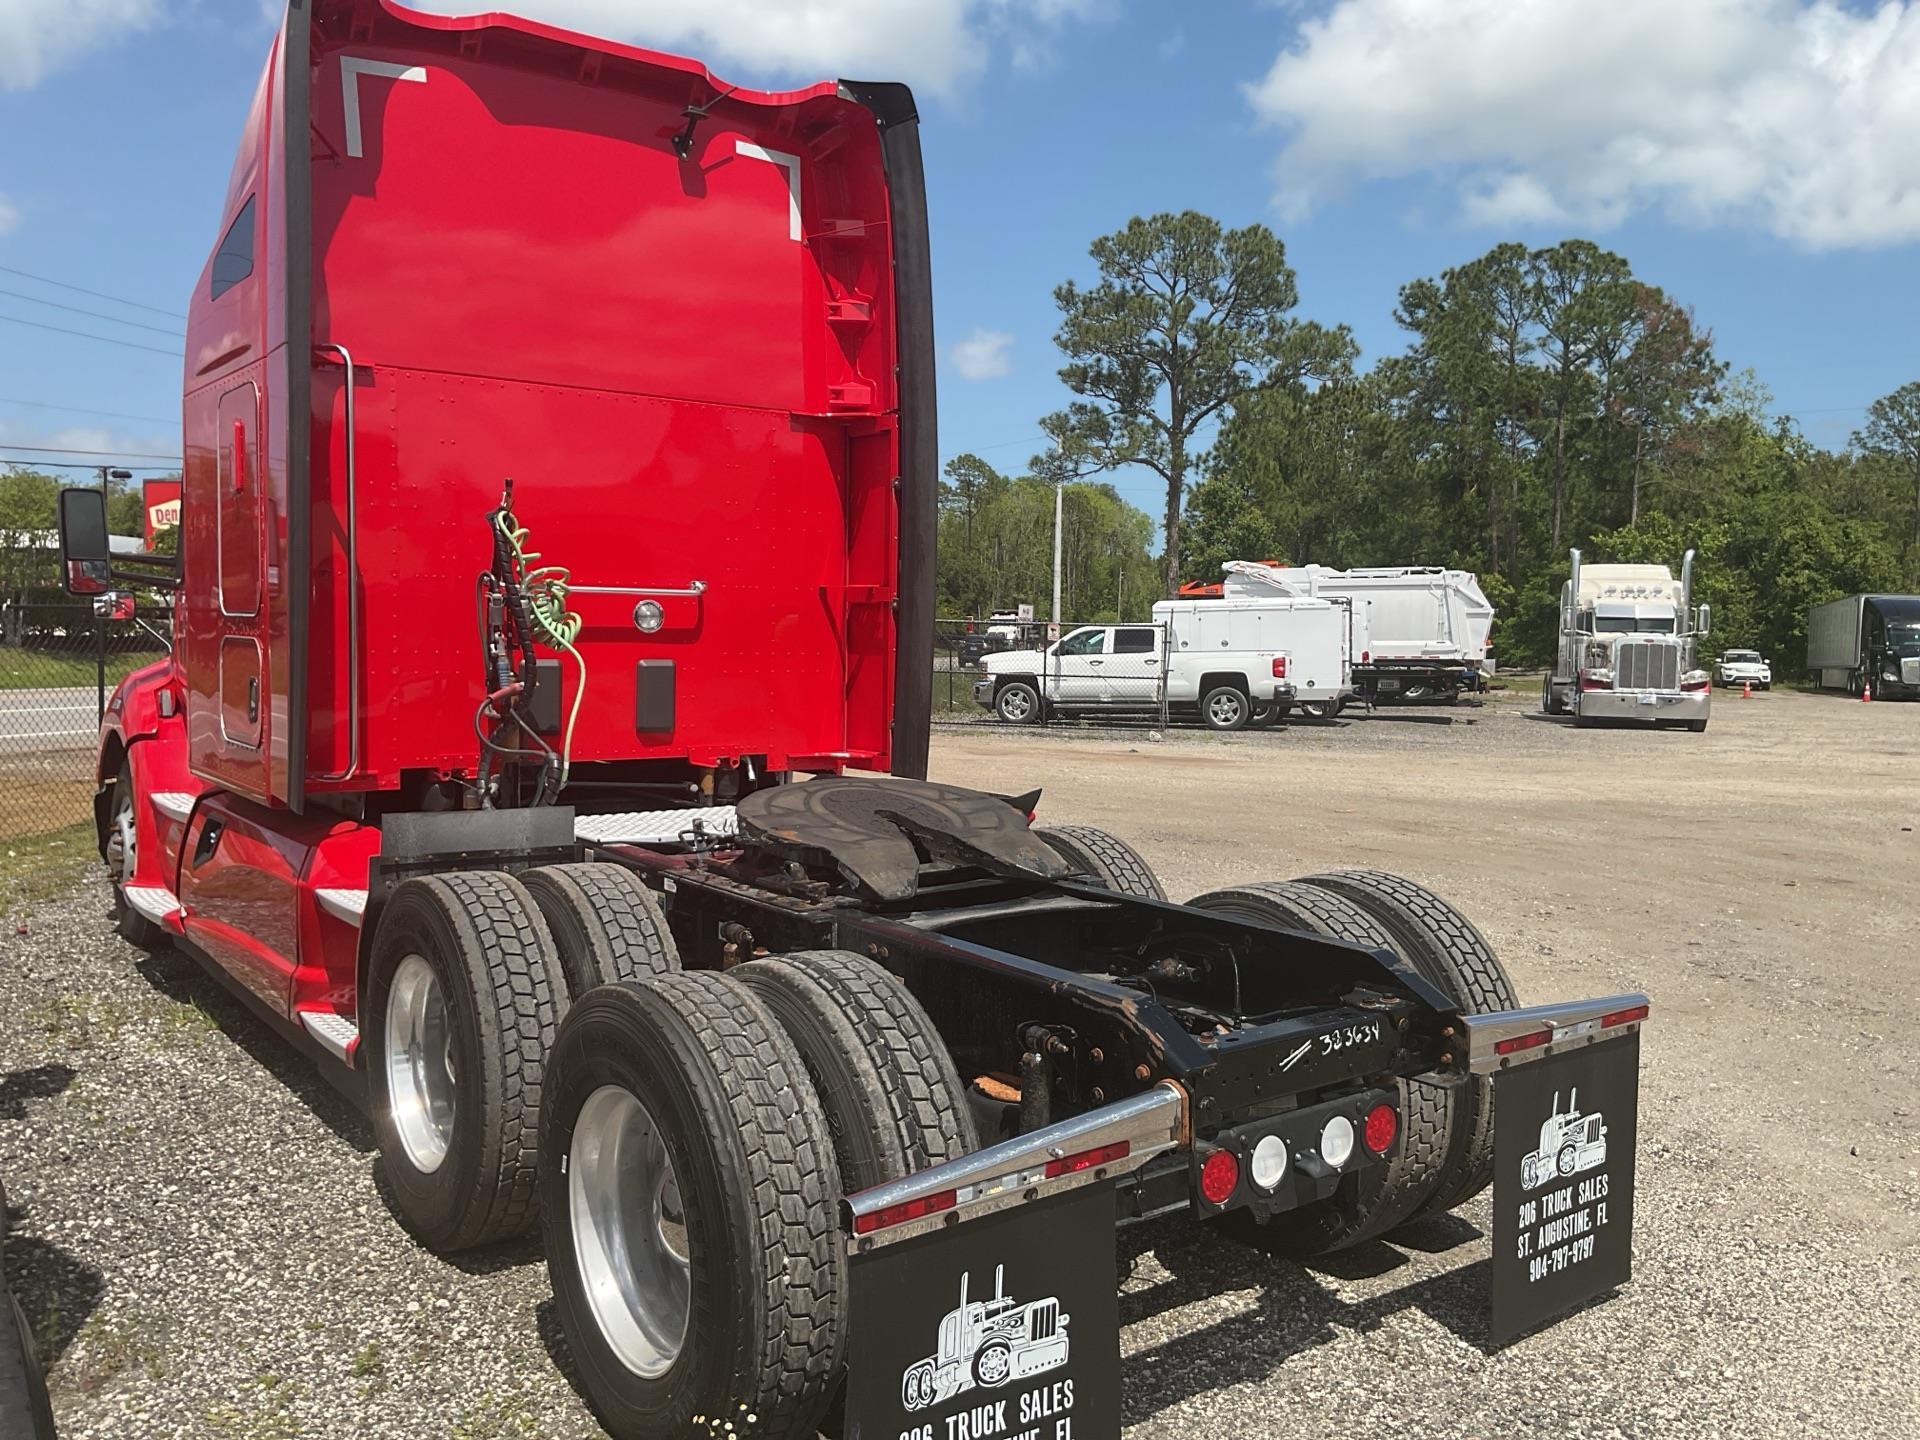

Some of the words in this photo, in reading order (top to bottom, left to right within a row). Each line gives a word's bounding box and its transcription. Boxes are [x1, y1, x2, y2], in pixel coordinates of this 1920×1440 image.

[1519, 1200, 1536, 1229] 206
[1542, 1186, 1573, 1219] TRUCK
[1579, 1173, 1609, 1204] SALES
[1518, 1232, 1533, 1259] ST.
[1597, 1202, 1608, 1226] FL
[1529, 1234, 1594, 1282] 904-797-9797
[945, 1400, 1007, 1440] TRUCK
[1019, 1379, 1074, 1423] SALES
